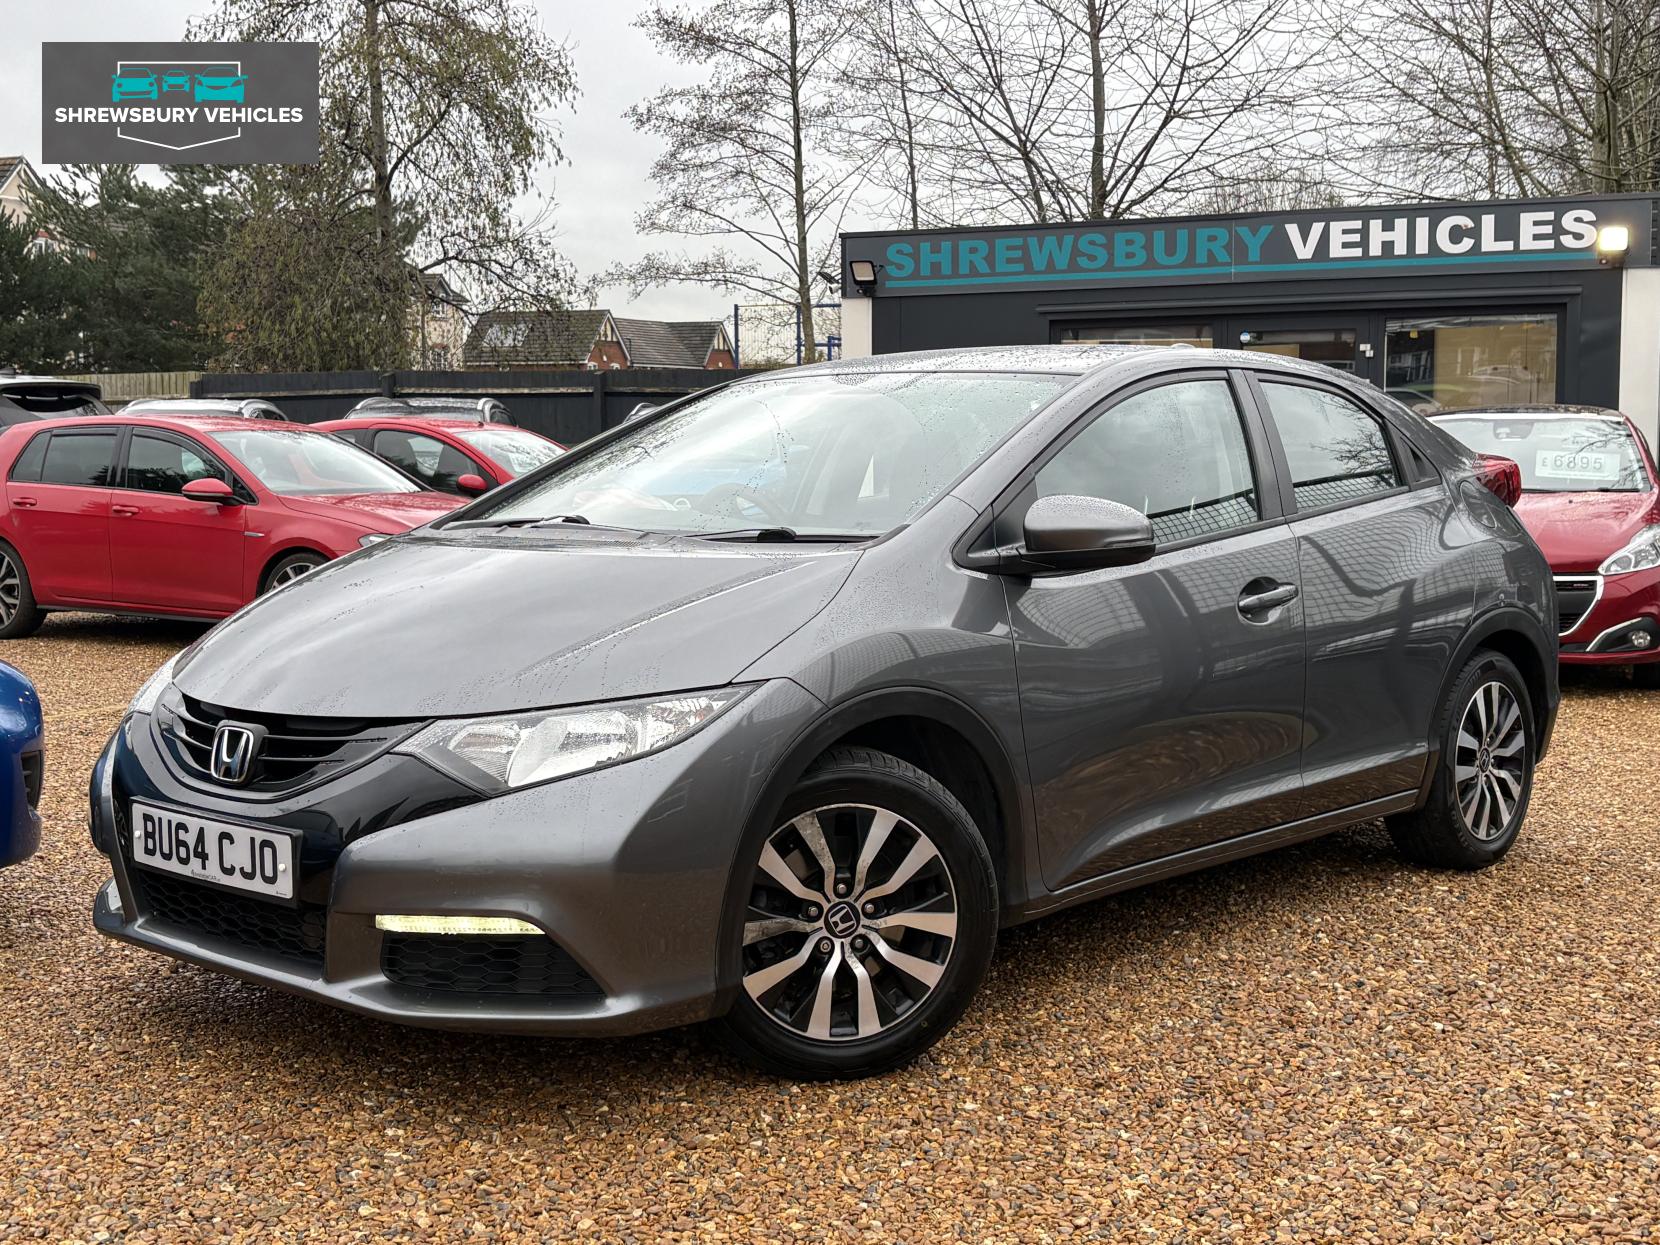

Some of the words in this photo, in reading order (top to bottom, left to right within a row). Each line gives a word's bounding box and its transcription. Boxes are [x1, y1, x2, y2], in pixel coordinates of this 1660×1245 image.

[886, 224, 1274, 278] SHREWSBURY
[1284, 209, 1598, 261] VEHICLES
[142, 812, 209, 870] BU64
[218, 831, 279, 885] CJO
